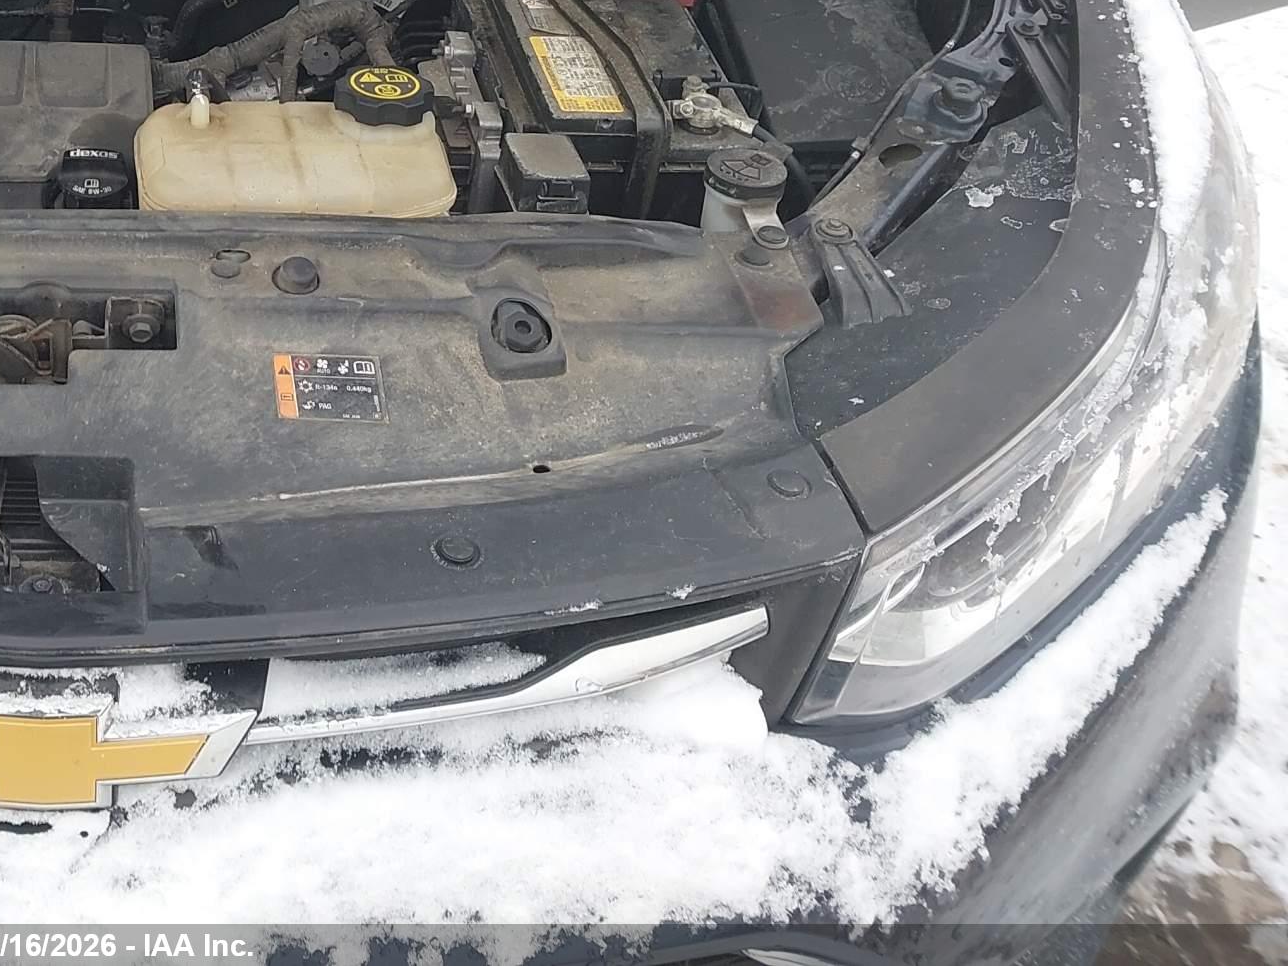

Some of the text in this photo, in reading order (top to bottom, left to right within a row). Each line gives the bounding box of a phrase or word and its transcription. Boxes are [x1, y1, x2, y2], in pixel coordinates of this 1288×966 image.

[69, 148, 119, 159] dexos
[315, 383, 338, 391] R-134a
[318, 402, 333, 410] PAG
